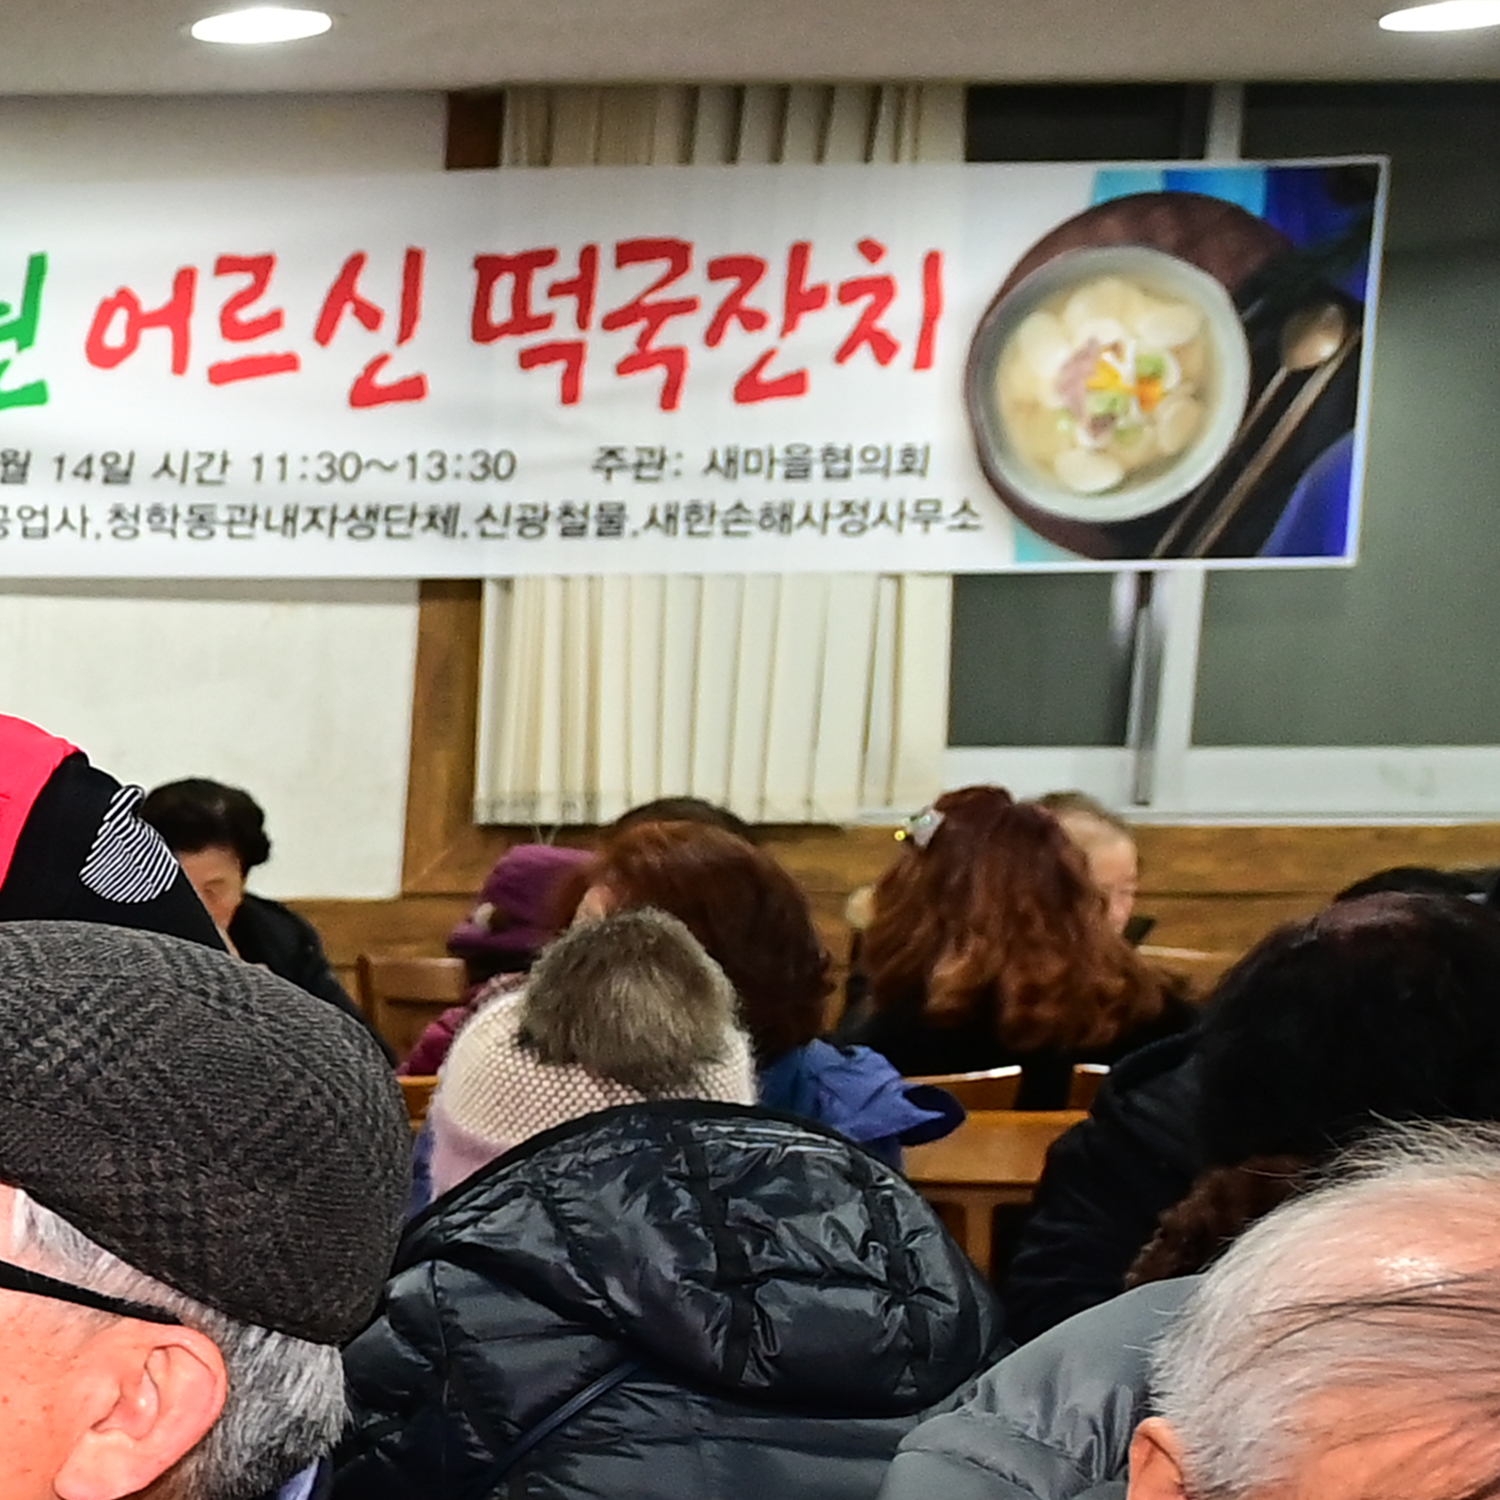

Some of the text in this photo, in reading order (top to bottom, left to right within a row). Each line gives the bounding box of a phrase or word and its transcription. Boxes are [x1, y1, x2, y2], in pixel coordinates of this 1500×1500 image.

[85, 245, 427, 409] 어르신
[471, 236, 944, 411] 떡국잔치
[52, 449, 136, 486] 14일
[151, 449, 231, 487] 시간
[251, 449, 517, 484] 11:30~13:30
[591, 444, 684, 484] 주관:
[702, 442, 931, 482] 새마을협의회
